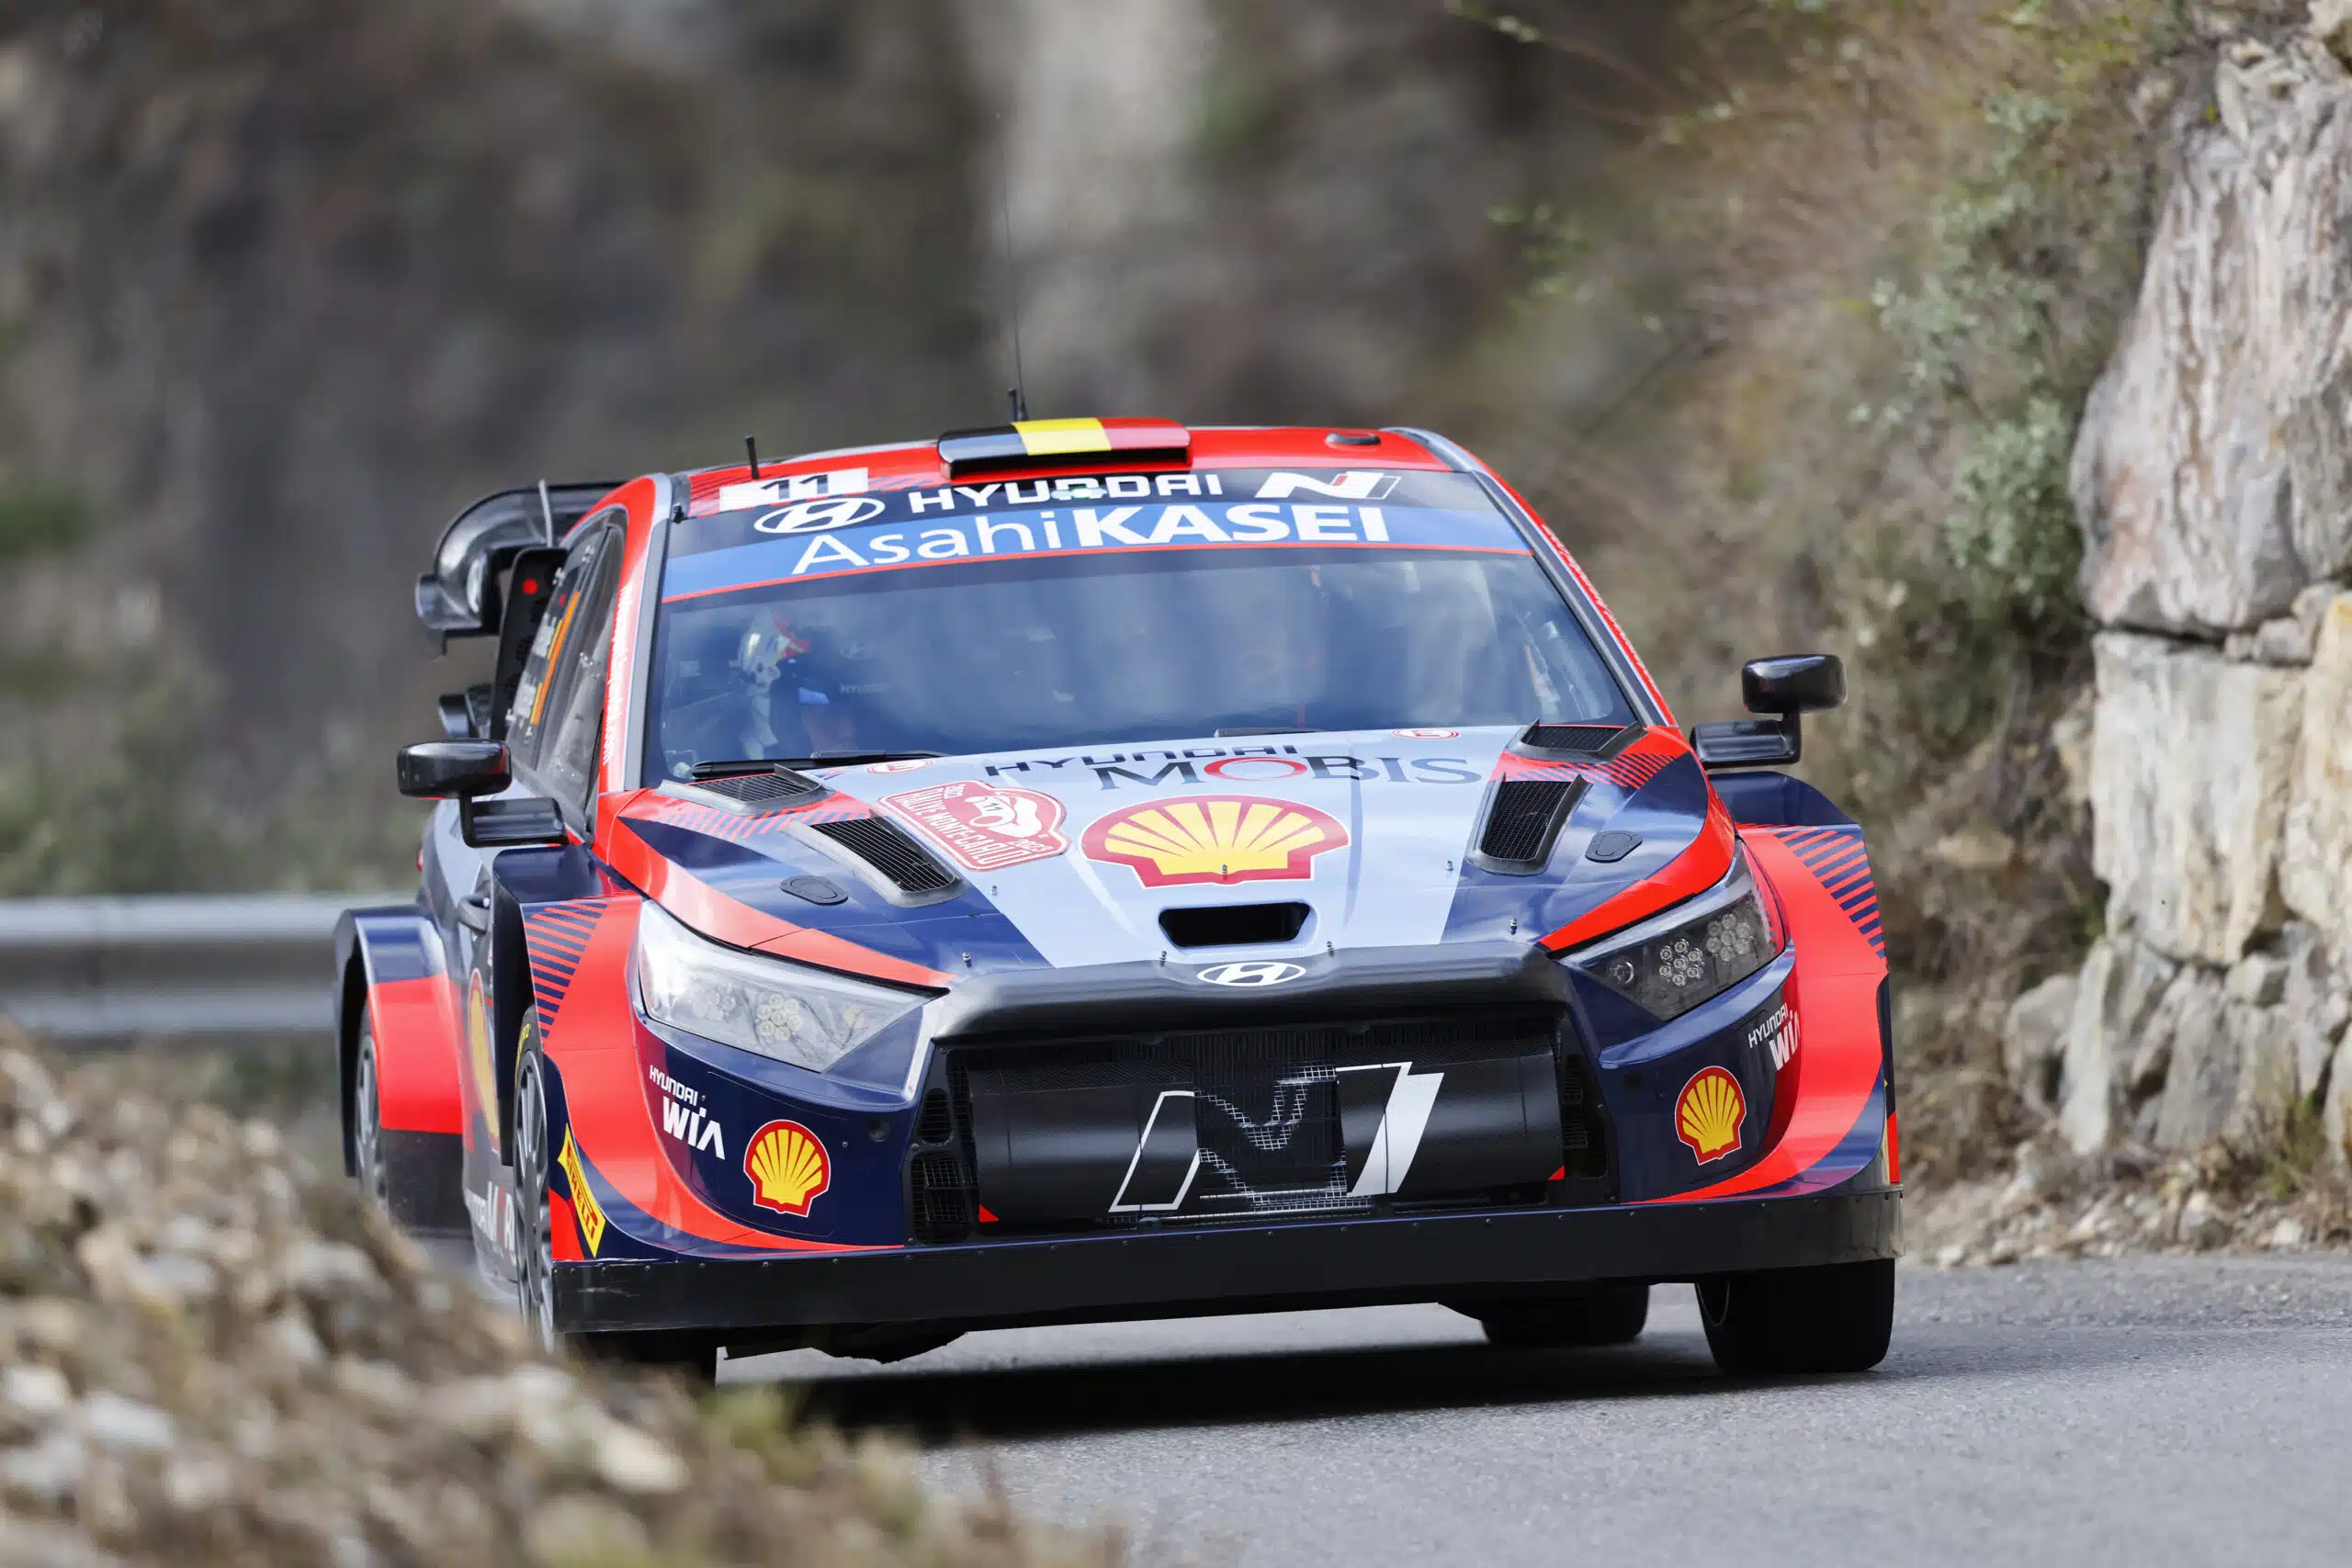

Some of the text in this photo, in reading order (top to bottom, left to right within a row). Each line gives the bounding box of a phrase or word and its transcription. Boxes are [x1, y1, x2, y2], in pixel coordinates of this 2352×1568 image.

[761, 474, 829, 500] 11
[907, 473, 1224, 513] HYUNDAI
[985, 744, 1298, 777] HYUNDAI
[1090, 755, 1482, 791] MOBIS
[1747, 1001, 1789, 1049] HYUNDAI
[649, 1065, 699, 1106] HYUNDAI
